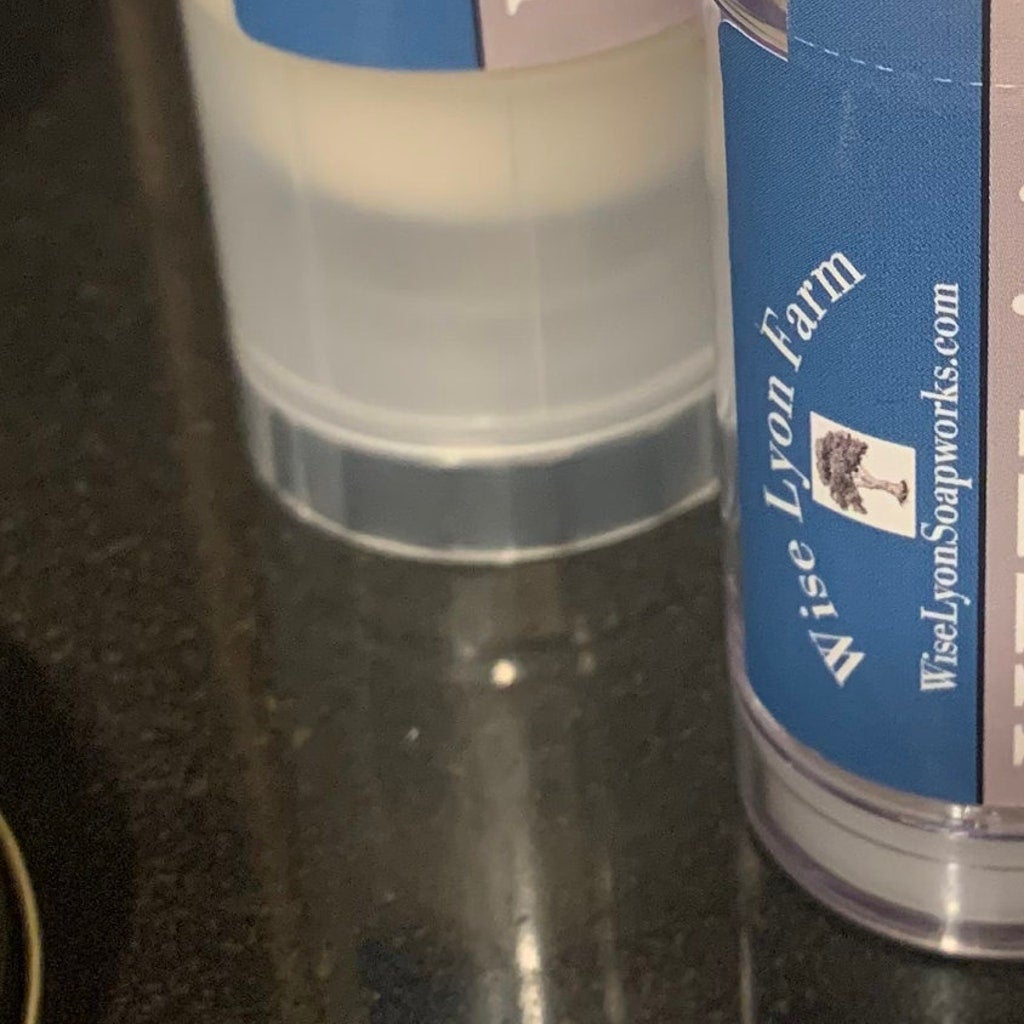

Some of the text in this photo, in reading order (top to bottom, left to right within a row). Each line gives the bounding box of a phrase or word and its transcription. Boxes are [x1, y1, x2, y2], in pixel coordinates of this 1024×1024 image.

[760, 250, 868, 686] Wise Lyon Farm
[919, 282, 973, 693] WiseLyonSoapworks.com
